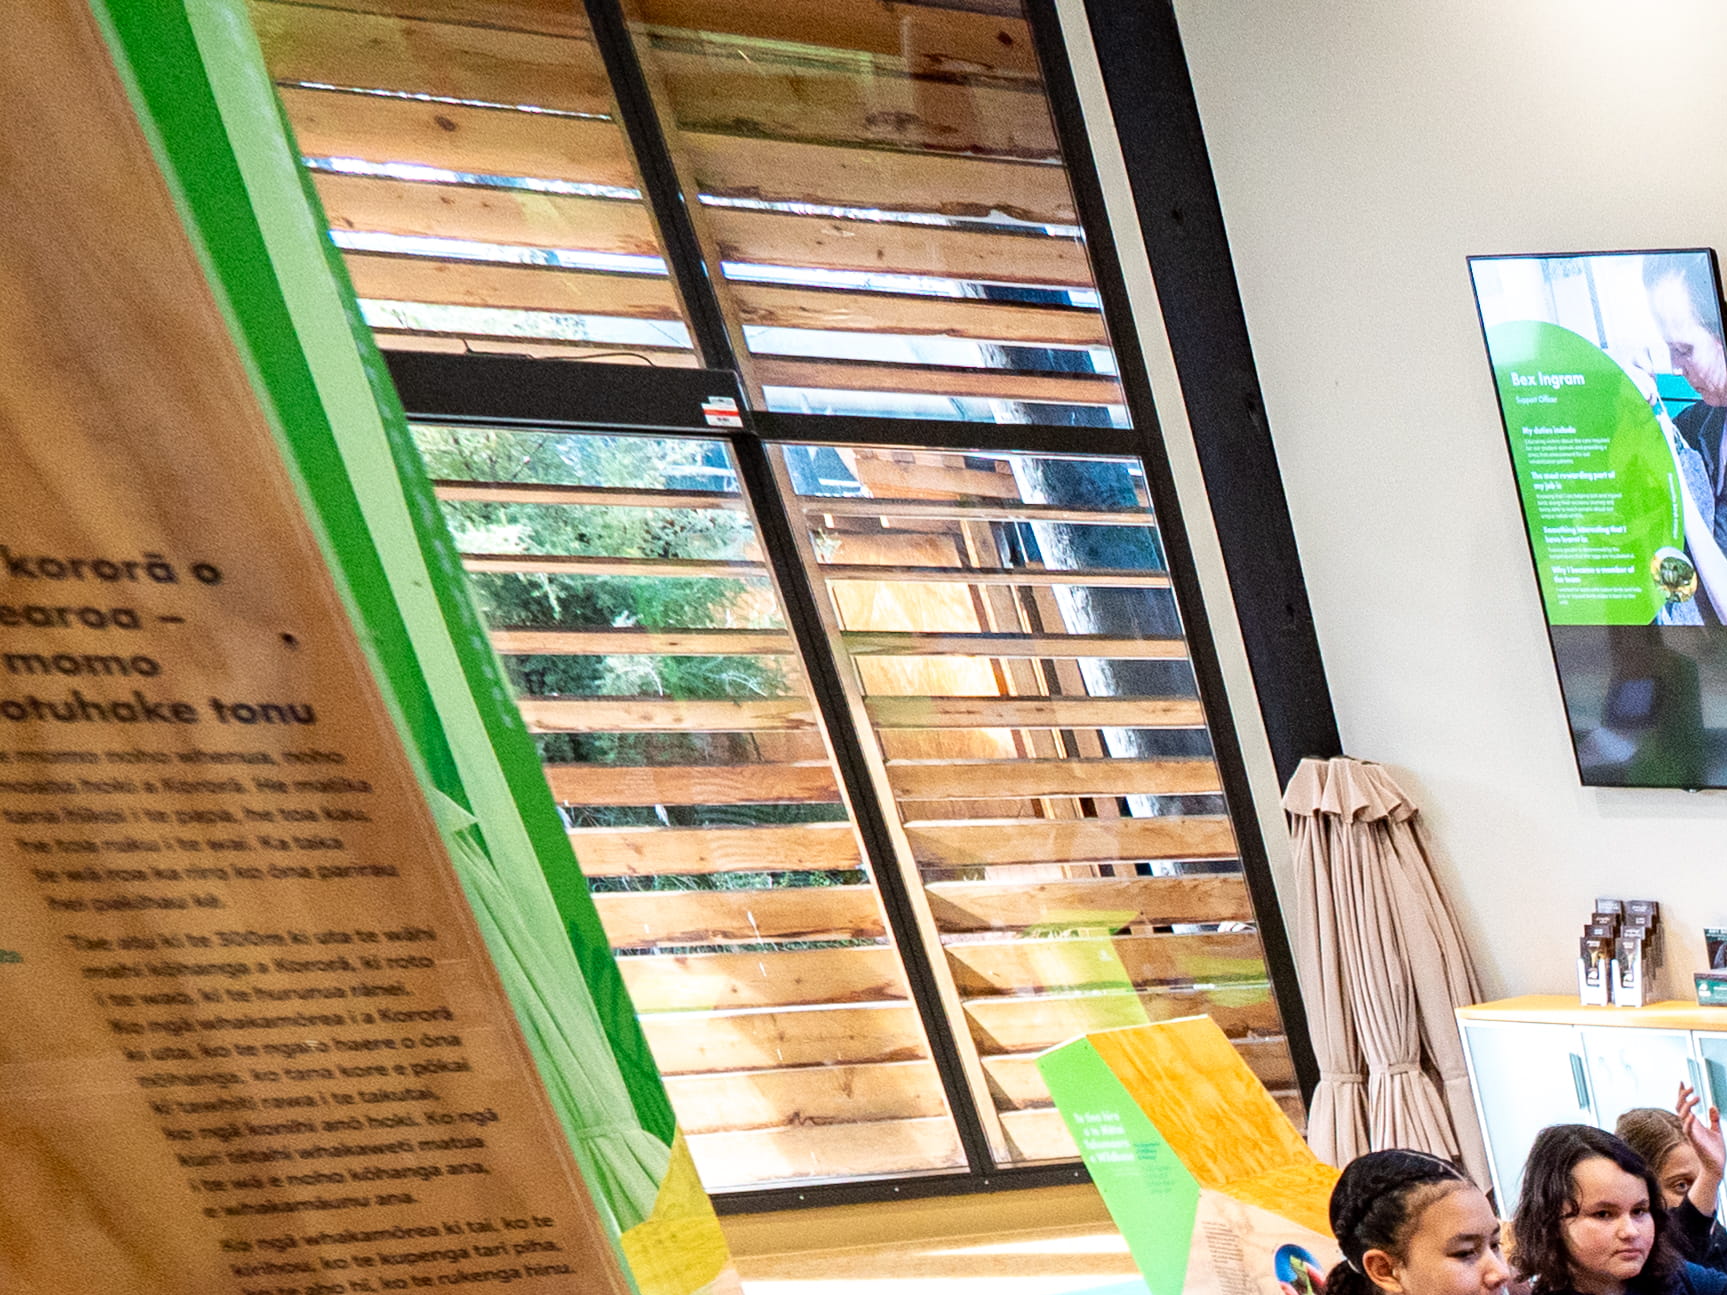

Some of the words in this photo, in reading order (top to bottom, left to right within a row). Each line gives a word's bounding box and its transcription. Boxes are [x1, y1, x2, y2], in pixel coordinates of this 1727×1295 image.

[1511, 372, 1536, 386] Bex
[1538, 372, 1585, 389] Ingram
[0, 545, 177, 584] kororā
[191, 562, 223, 585] o
[3, 652, 161, 677] momo
[208, 697, 316, 724] tonu
